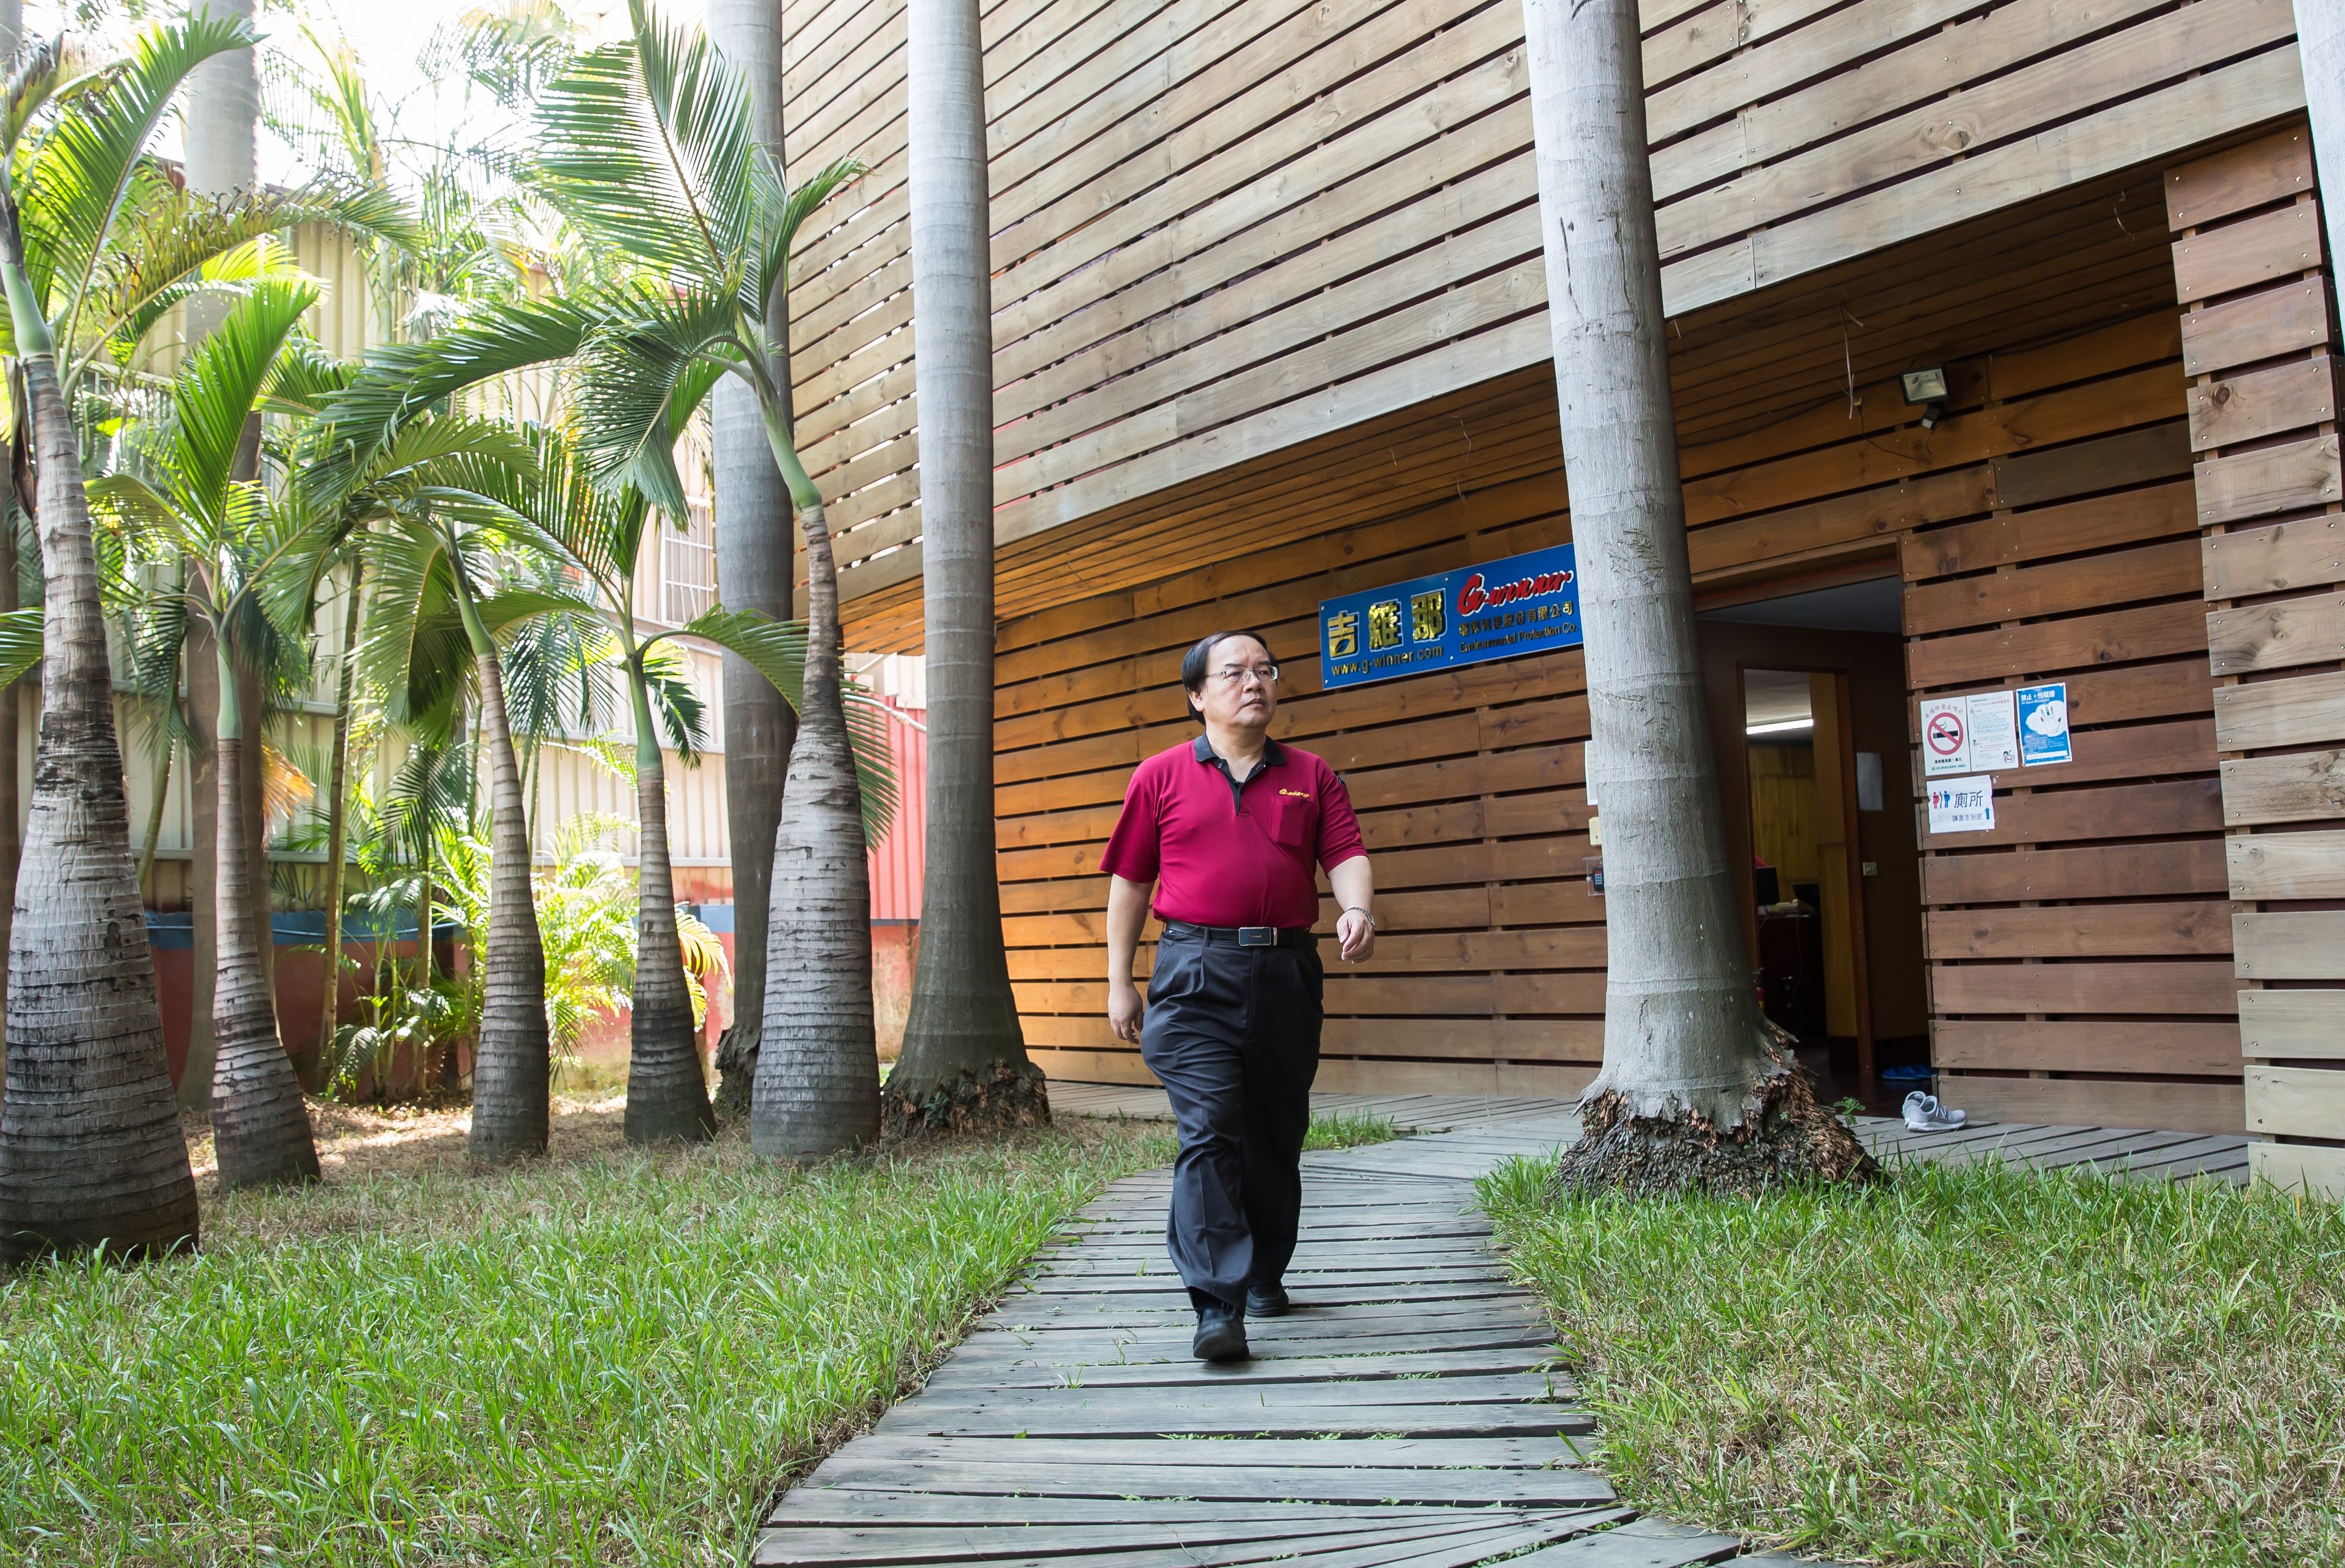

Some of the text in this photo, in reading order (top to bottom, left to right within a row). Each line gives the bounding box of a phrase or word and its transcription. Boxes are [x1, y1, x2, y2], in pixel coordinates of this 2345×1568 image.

[1518, 626, 1561, 642] Protection
[1562, 621, 1578, 633] Co.
[1331, 645, 1443, 676] www.g-winner.com
[1954, 790, 1983, 808] 廁所
